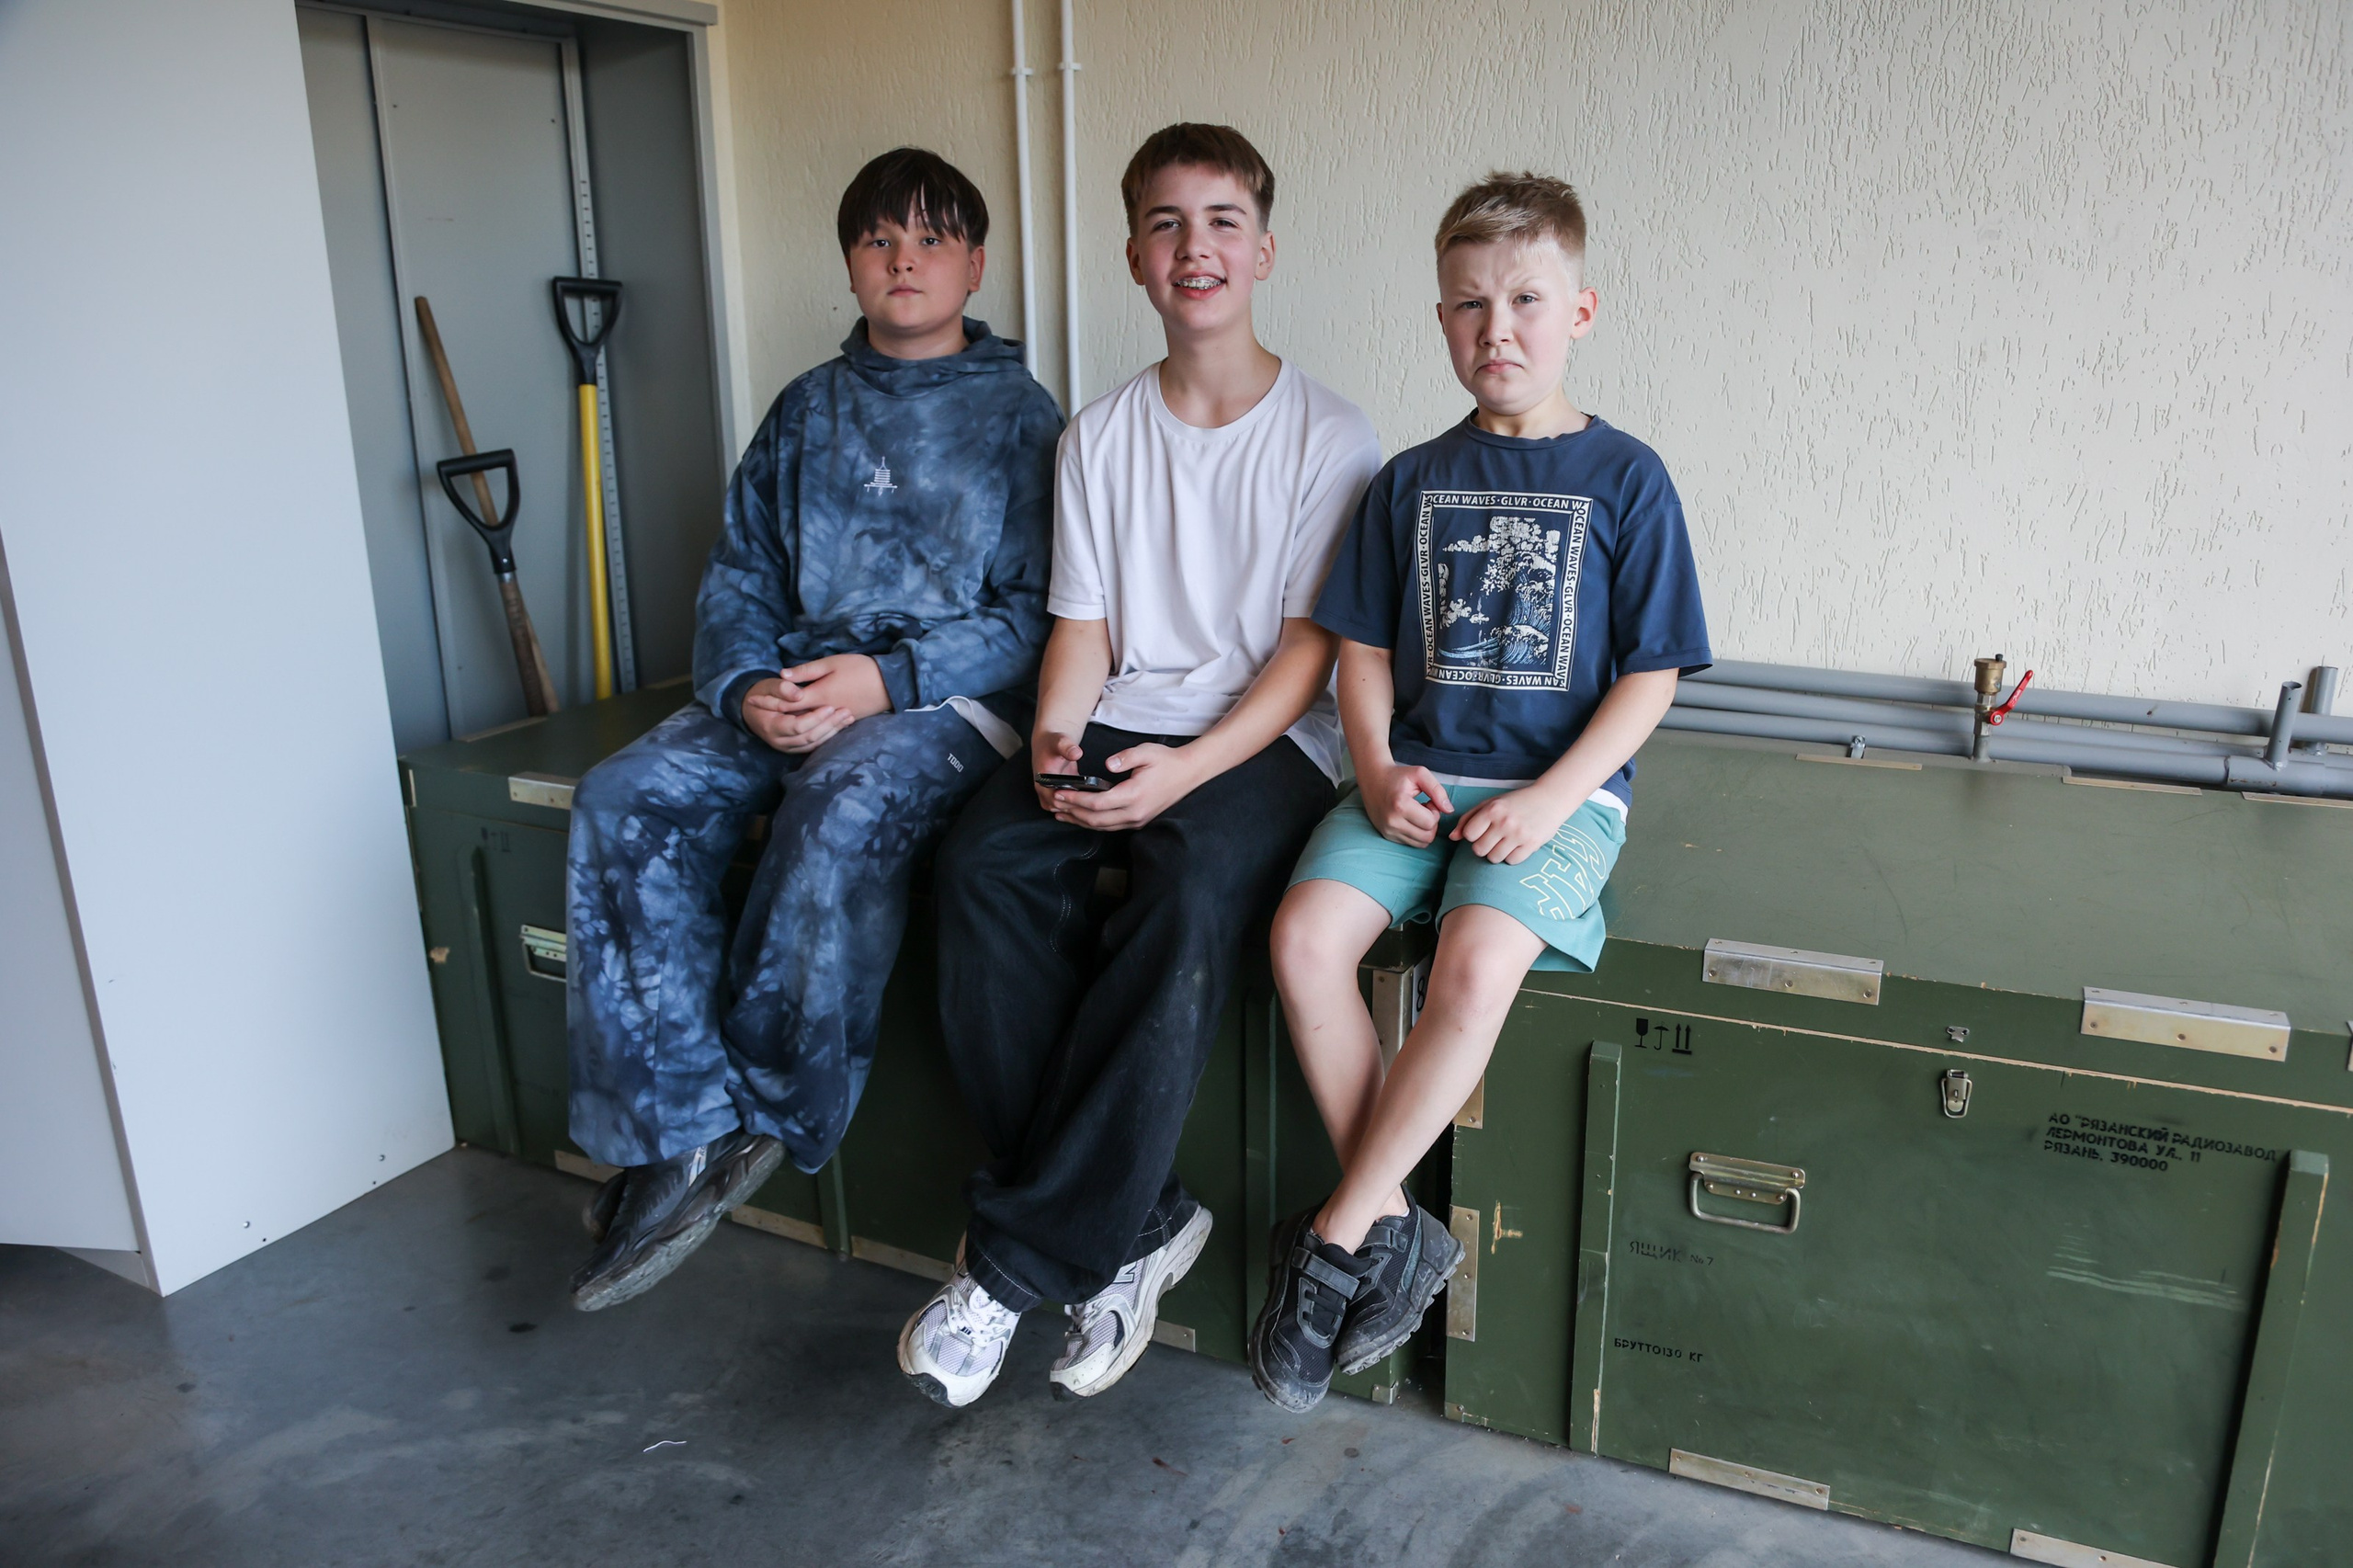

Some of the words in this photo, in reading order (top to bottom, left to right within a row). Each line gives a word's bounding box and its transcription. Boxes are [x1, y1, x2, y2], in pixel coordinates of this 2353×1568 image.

[1461, 495, 1496, 506] WAVES
[1500, 496, 1528, 506] GLVR
[1532, 497, 1569, 509] OCEAN
[1419, 511, 1430, 544] OCEAN
[1573, 508, 1586, 543] OCEAN
[1420, 551, 1428, 577] GLVR
[1567, 546, 1580, 582] WAVES
[1422, 581, 1431, 616] WAVES
[1564, 586, 1574, 613] GLVR
[1425, 619, 1433, 652] OCEAN
[1561, 619, 1573, 653] OCEAN
[1506, 676, 1541, 686] WAVES
[2048, 1112, 2071, 1125] АО
[2046, 1126, 2149, 1154] ЛЕРМОНТОВА
[2190, 1151, 2202, 1163] 11
[2110, 1151, 2169, 1172] 390000
[1630, 1241, 1682, 1263] ЯЩИК
[1688, 1351, 1703, 1363] КГ
